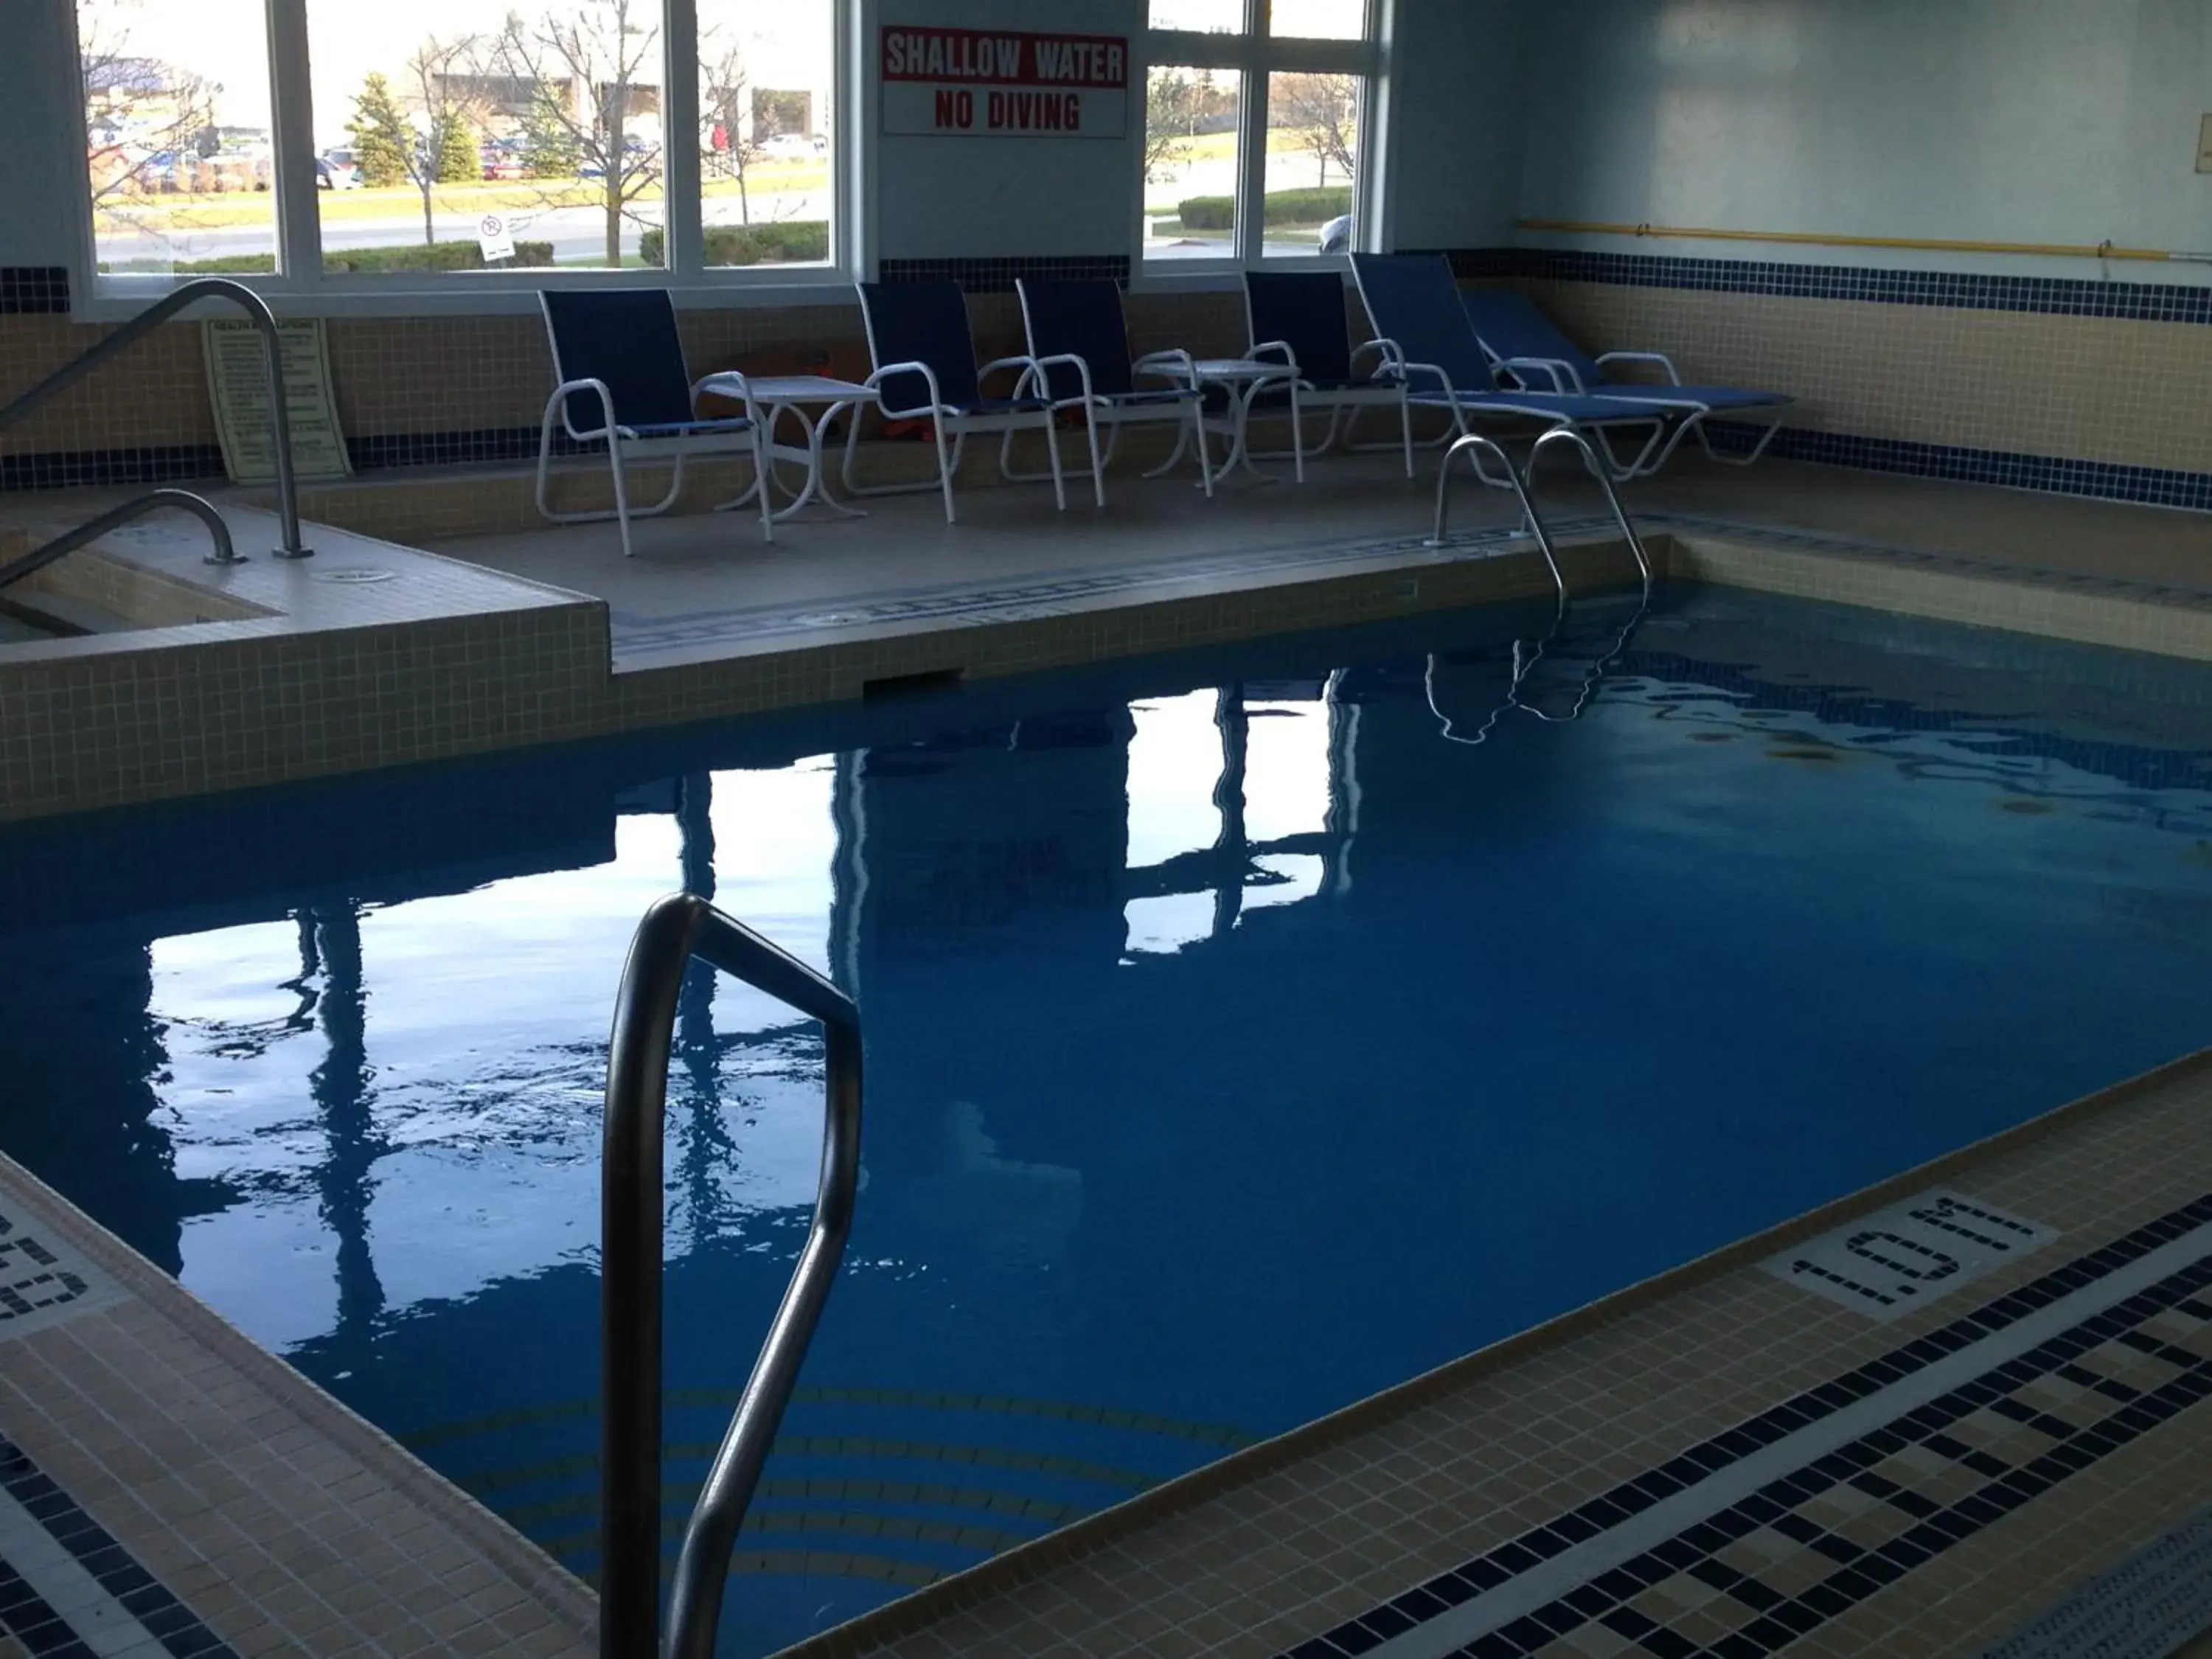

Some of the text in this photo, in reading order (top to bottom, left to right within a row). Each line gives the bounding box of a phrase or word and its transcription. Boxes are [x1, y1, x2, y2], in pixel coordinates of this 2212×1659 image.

[887, 32, 1124, 82] SHALLOW WATER
[935, 89, 1080, 130] NO DIVING
